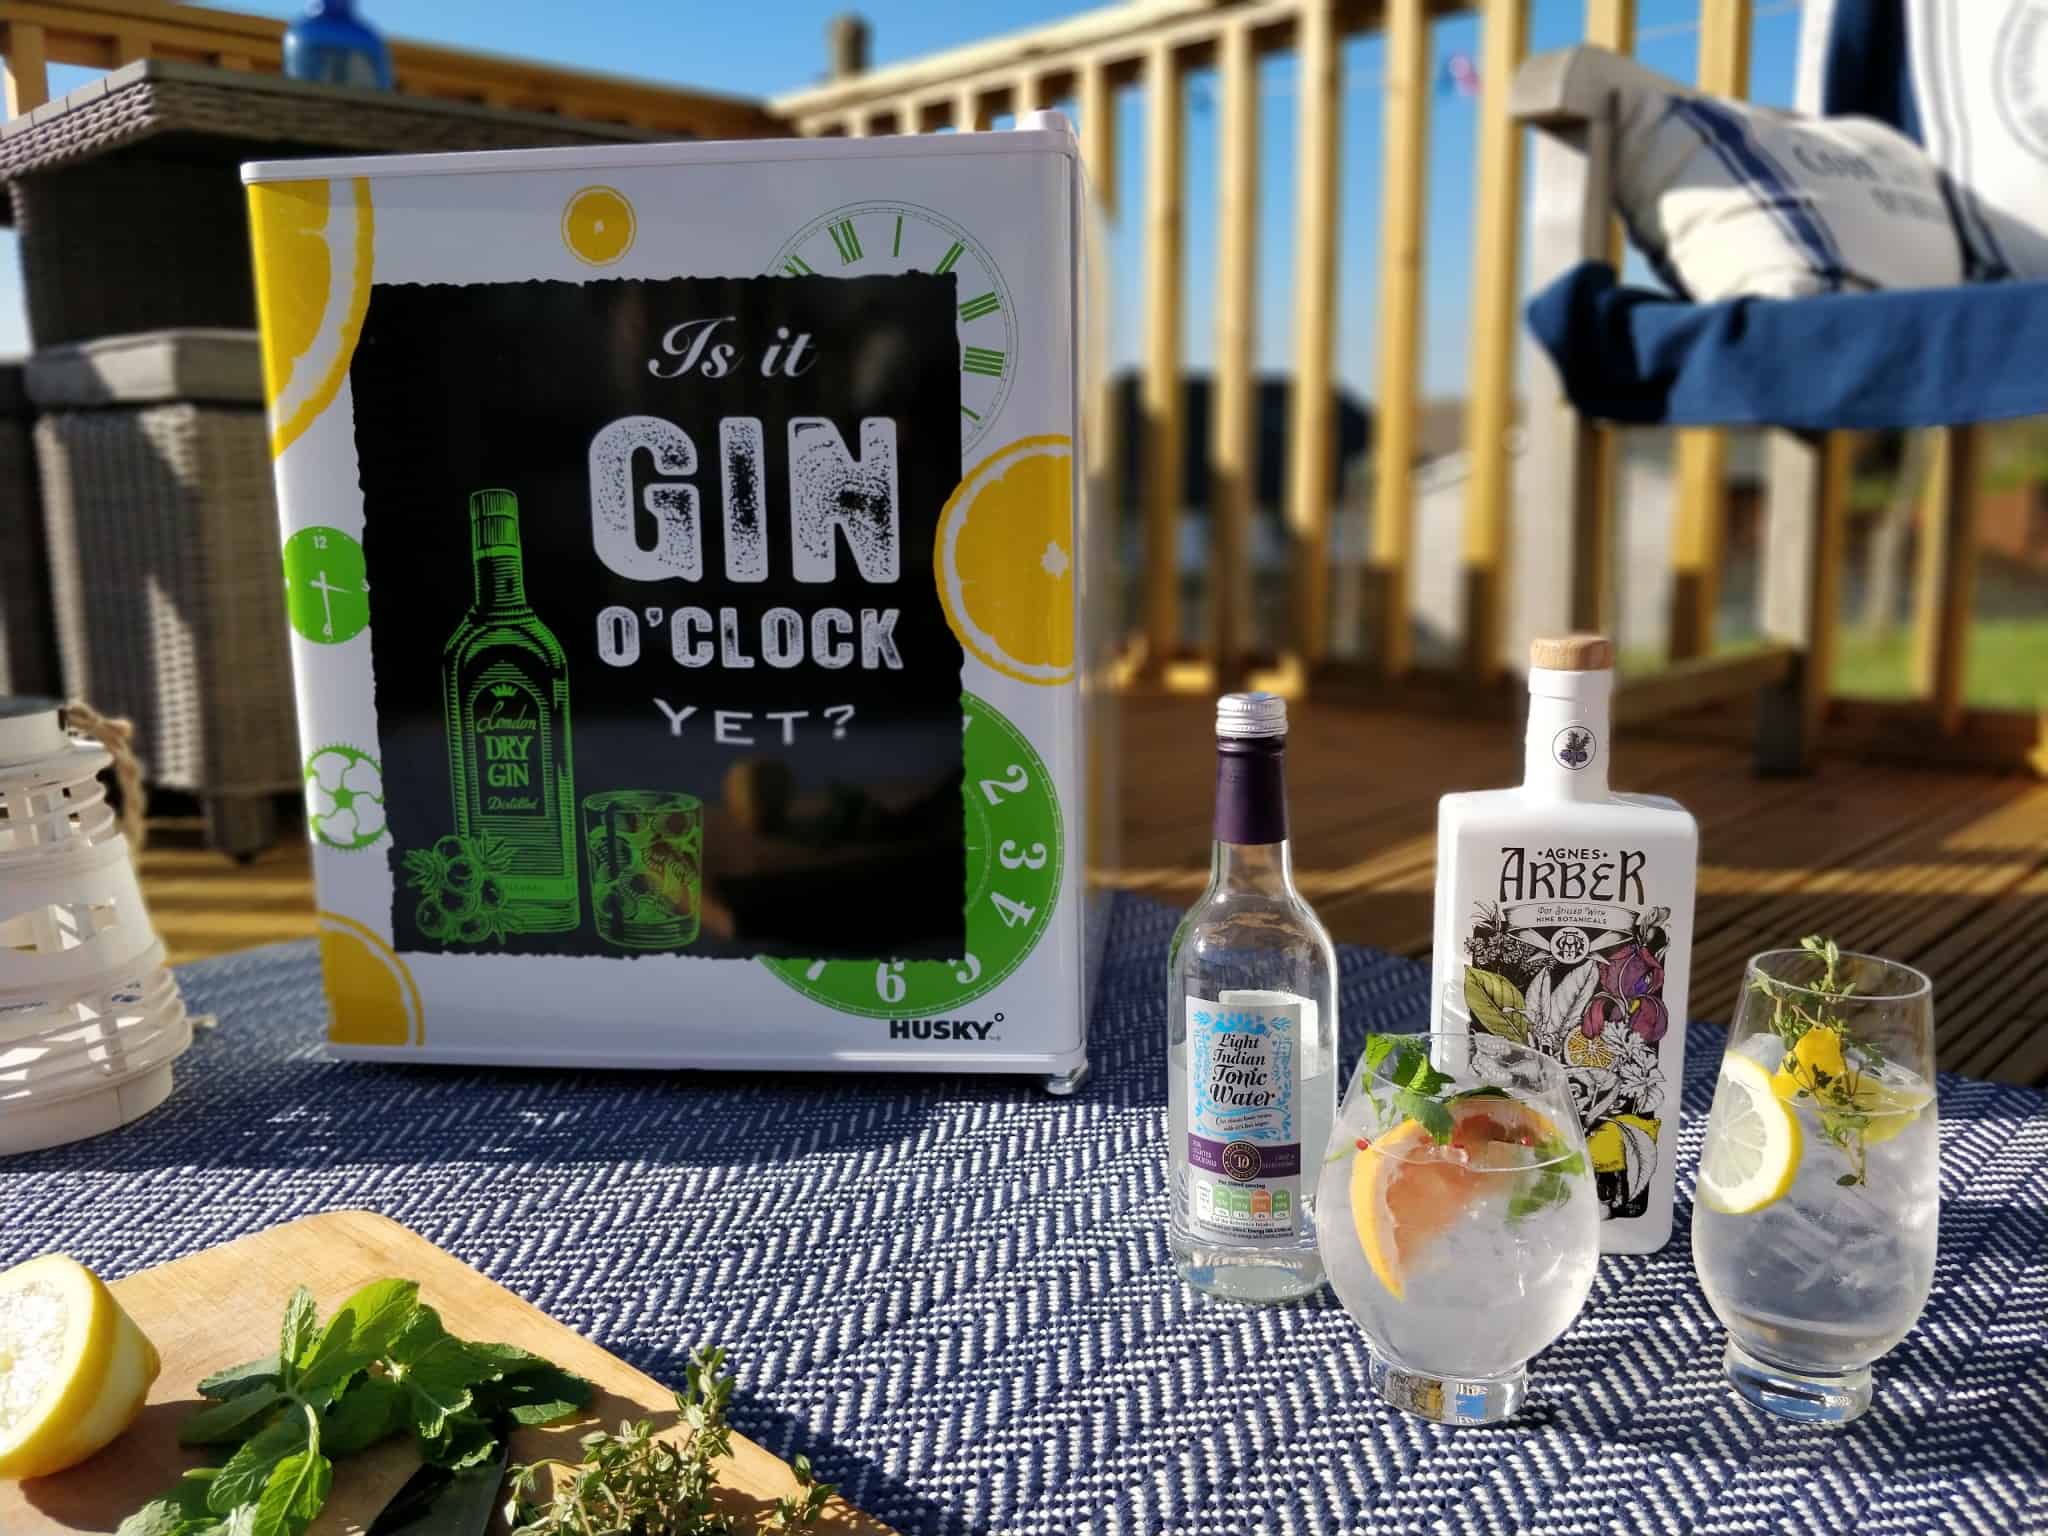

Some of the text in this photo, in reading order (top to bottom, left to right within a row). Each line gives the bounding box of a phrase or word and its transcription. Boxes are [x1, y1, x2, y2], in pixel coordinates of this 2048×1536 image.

[647, 316, 817, 378] Is it
[589, 415, 900, 584] GIN
[313, 535, 329, 549] 12
[597, 606, 903, 670] O'CLOCK
[476, 701, 537, 733] London
[653, 698, 855, 745] YET?
[485, 735, 534, 760] DRY
[487, 763, 528, 787] GIN
[979, 764, 1029, 806] 2
[999, 839, 1048, 870] 3
[1545, 848, 1601, 860] AGNES
[1500, 847, 1646, 905] ARBER
[990, 891, 1037, 928] 4
[1218, 1032, 1260, 1051] Light
[1213, 1049, 1265, 1066] Indian
[1212, 1065, 1268, 1088] Tonic
[1210, 1083, 1276, 1107] Water
